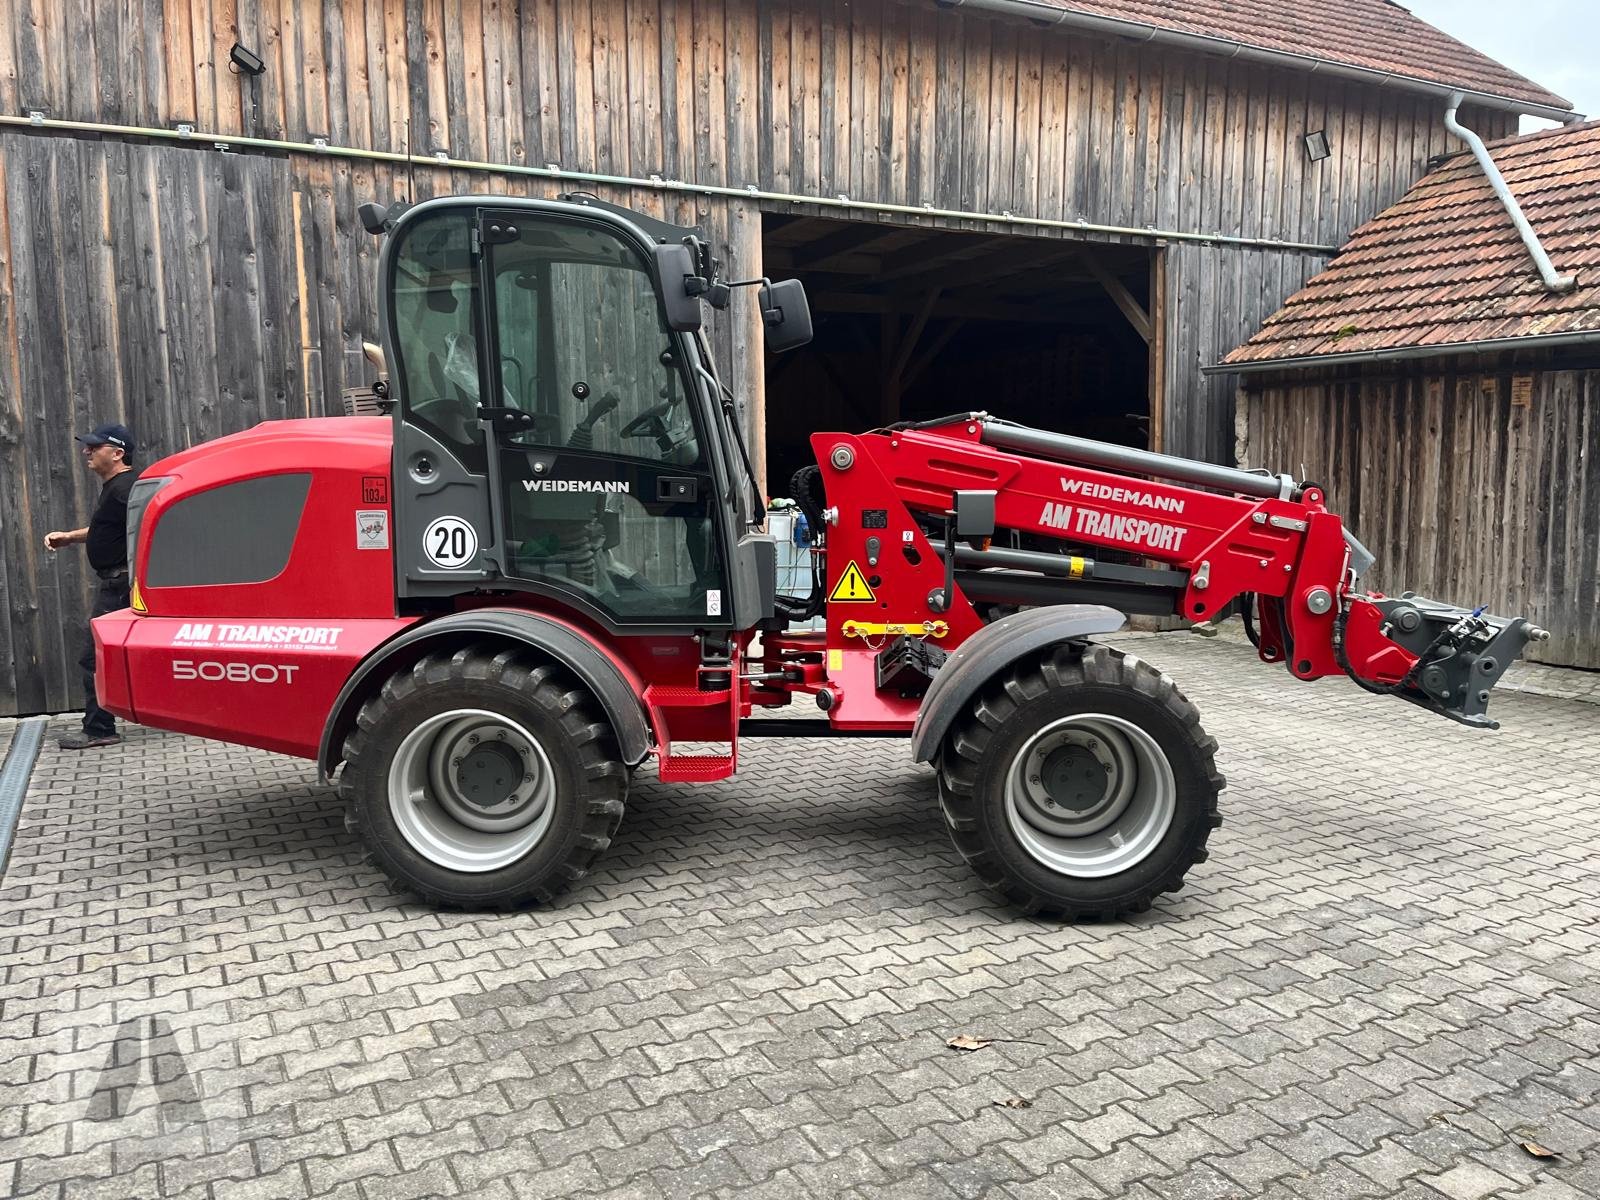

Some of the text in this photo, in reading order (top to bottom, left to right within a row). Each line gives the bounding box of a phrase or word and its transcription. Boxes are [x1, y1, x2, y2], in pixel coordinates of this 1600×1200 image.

[365, 488, 379, 502] 103
[522, 480, 630, 493] WEIDEMANN
[1060, 477, 1185, 514] WEIDEMANN
[1038, 502, 1188, 552] AM TRANSPORT
[435, 526, 467, 559] 20
[174, 623, 344, 645] AM TRANSPORT
[172, 660, 300, 685] 5080T
